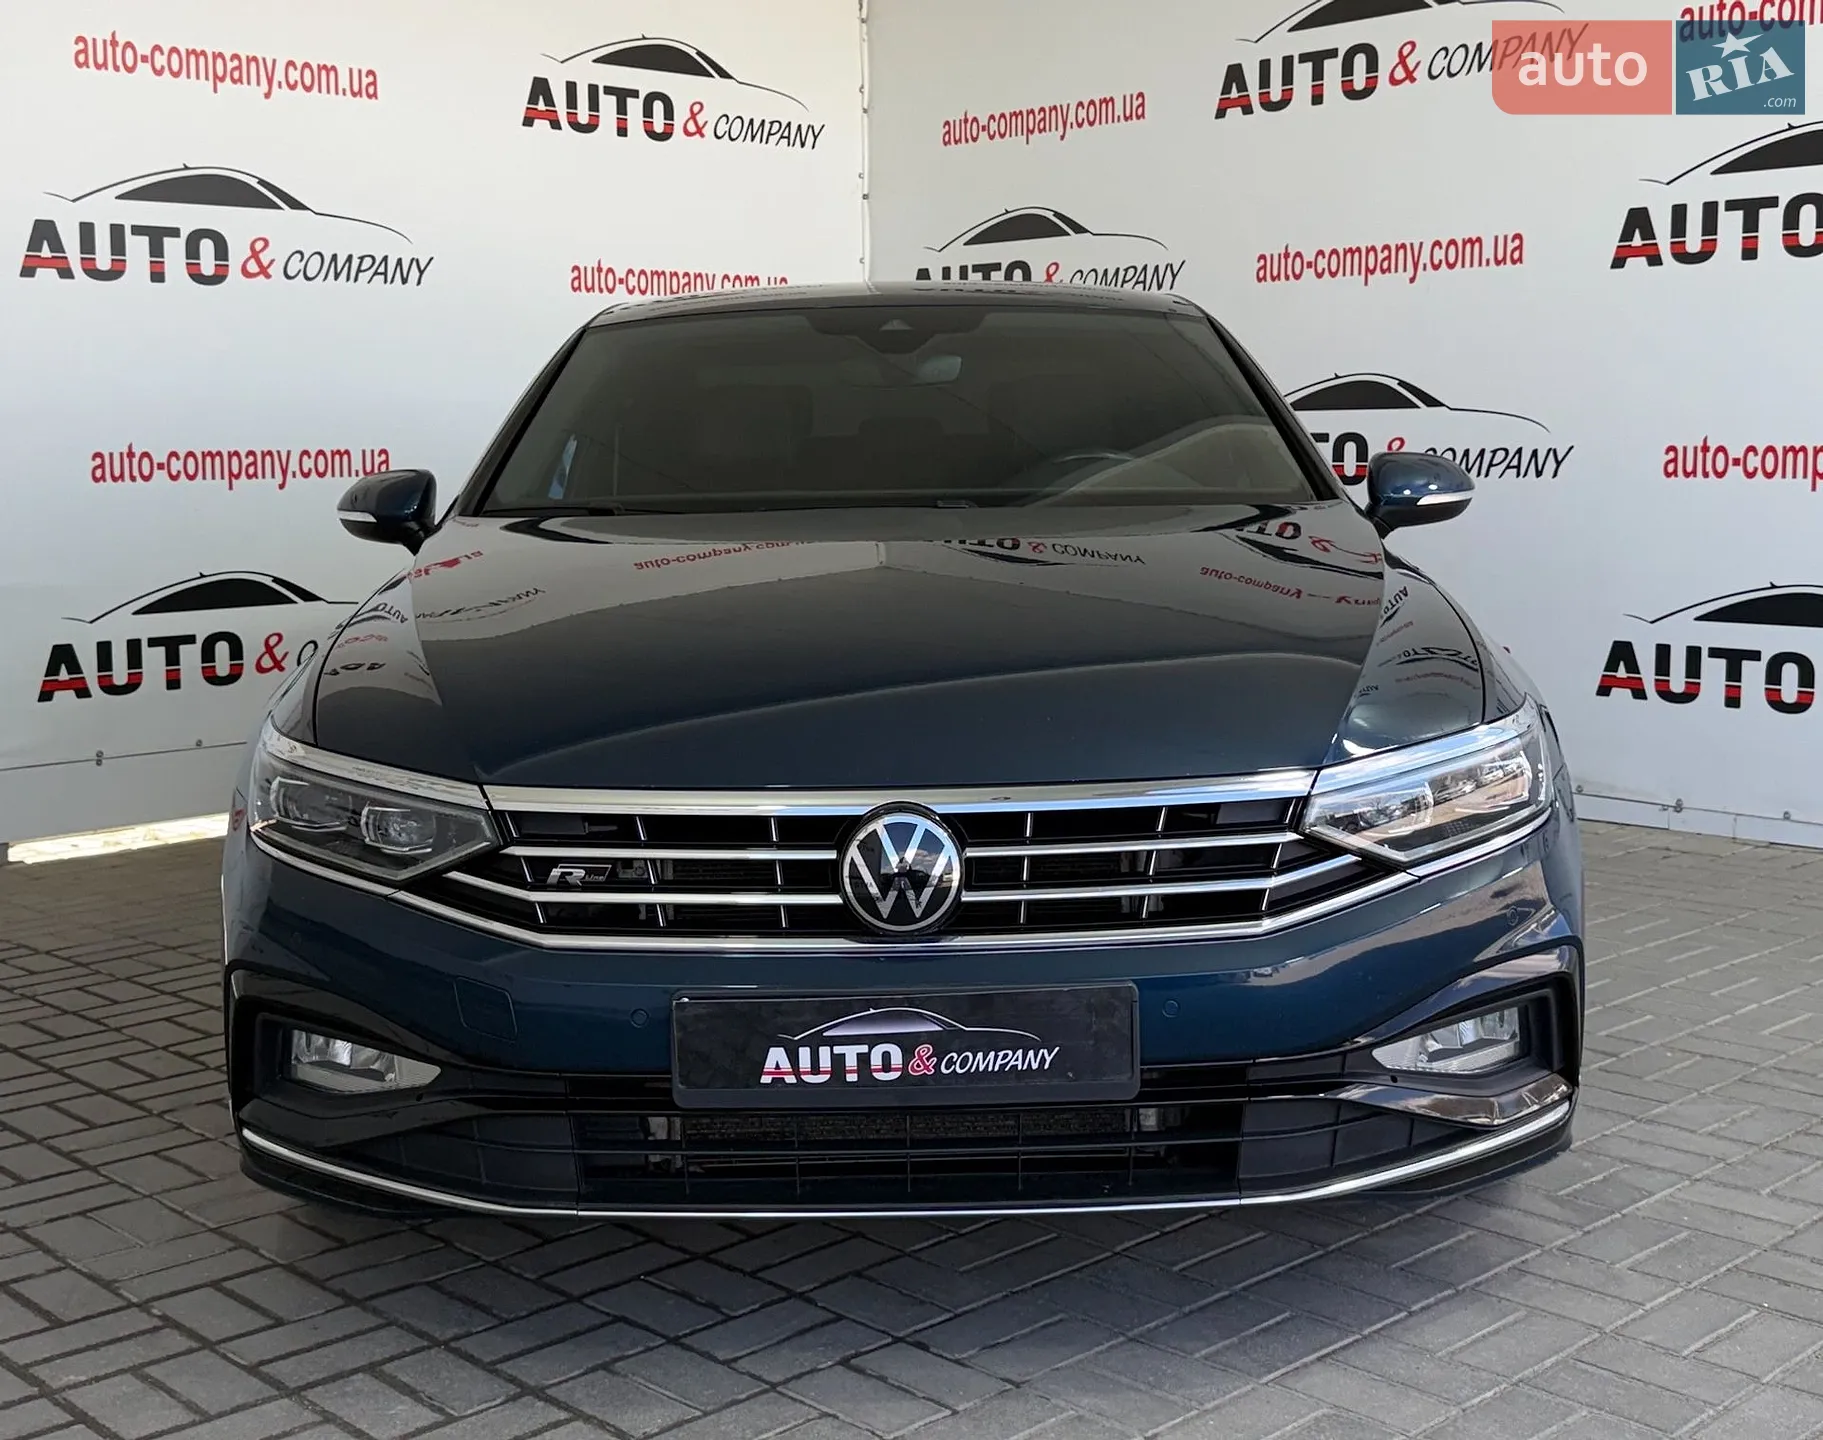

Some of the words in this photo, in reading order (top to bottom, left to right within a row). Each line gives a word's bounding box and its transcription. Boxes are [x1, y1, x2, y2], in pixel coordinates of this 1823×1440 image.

[73, 31, 378, 100] auto-company.com.ua
[1215, 42, 1379, 119] AUTO
[1388, 41, 1421, 86] &
[1427, 23, 1589, 81] COMPANY
[522, 76, 675, 142] AUTO
[682, 101, 708, 138] &
[713, 114, 825, 149] COMPANY
[942, 91, 1146, 146] auto-company.com.ua
[19, 219, 230, 286] AUTO
[240, 237, 275, 279] &
[282, 250, 434, 286] COMPANY
[1255, 232, 1524, 286] auto-company.com.ua
[1610, 192, 1823, 269] AUTO
[91, 443, 390, 489] auto-company.com.ua
[37, 631, 244, 702] AUTO
[255, 632, 289, 674] &
[1596, 640, 1816, 714] AUTO
[760, 1044, 903, 1085] AUTO
[908, 1044, 937, 1077] &
[940, 1046, 1060, 1075] COMPANY
